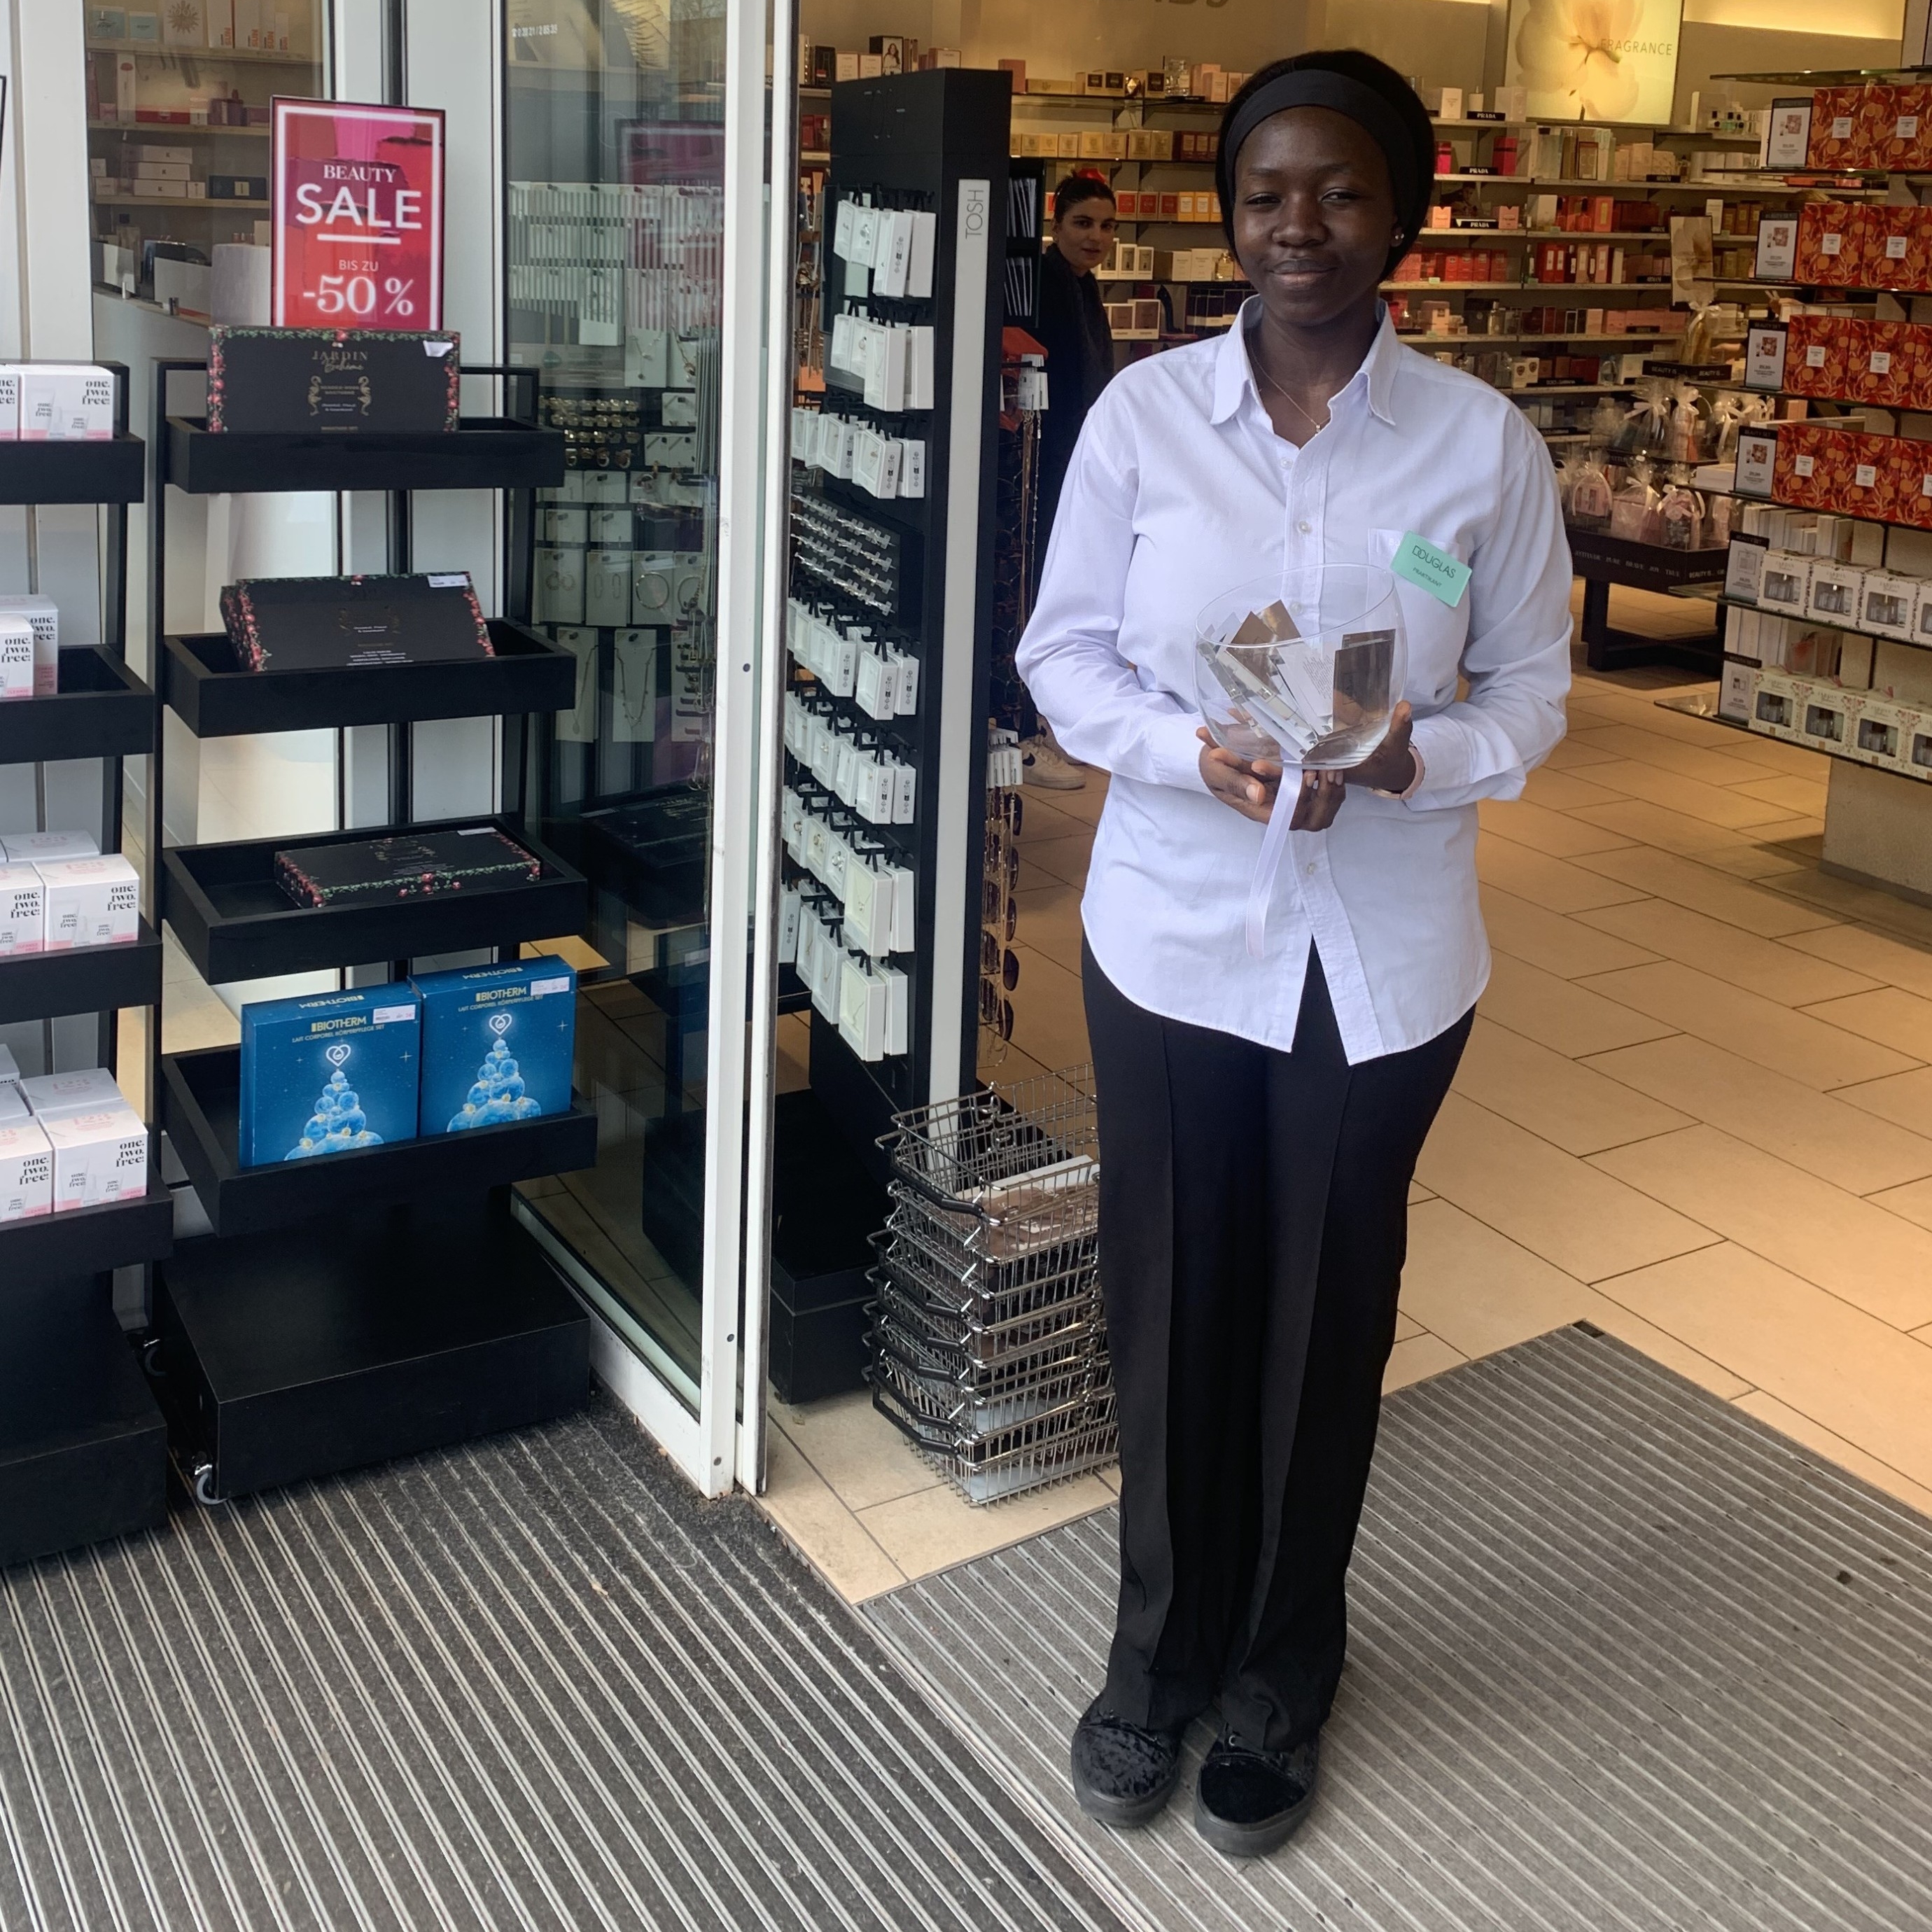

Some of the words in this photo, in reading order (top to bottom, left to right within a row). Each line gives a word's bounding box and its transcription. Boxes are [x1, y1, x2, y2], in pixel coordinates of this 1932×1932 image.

[1600, 38, 1672, 55] FRAGRANCE
[323, 164, 396, 183] BEAUTY
[295, 183, 423, 230] SALE
[965, 190, 984, 239] TOSH
[339, 260, 358, 271] BIS
[361, 261, 379, 272] ZU
[303, 274, 377, 314] -50
[384, 277, 414, 315] %
[312, 351, 368, 360] JARDIN
[1412, 545, 1456, 578] DOUGLAS
[111, 885, 136, 893] one.
[14, 892, 40, 900] one.
[15, 901, 40, 909] two.
[480, 986, 526, 1001] BIOTHERM
[316, 1016, 367, 1031] BIOTHERM
[120, 1140, 144, 1149] one.
[120, 1149, 144, 1158] two.
[23, 1156, 49, 1167] one.
[24, 1166, 49, 1176] two.
